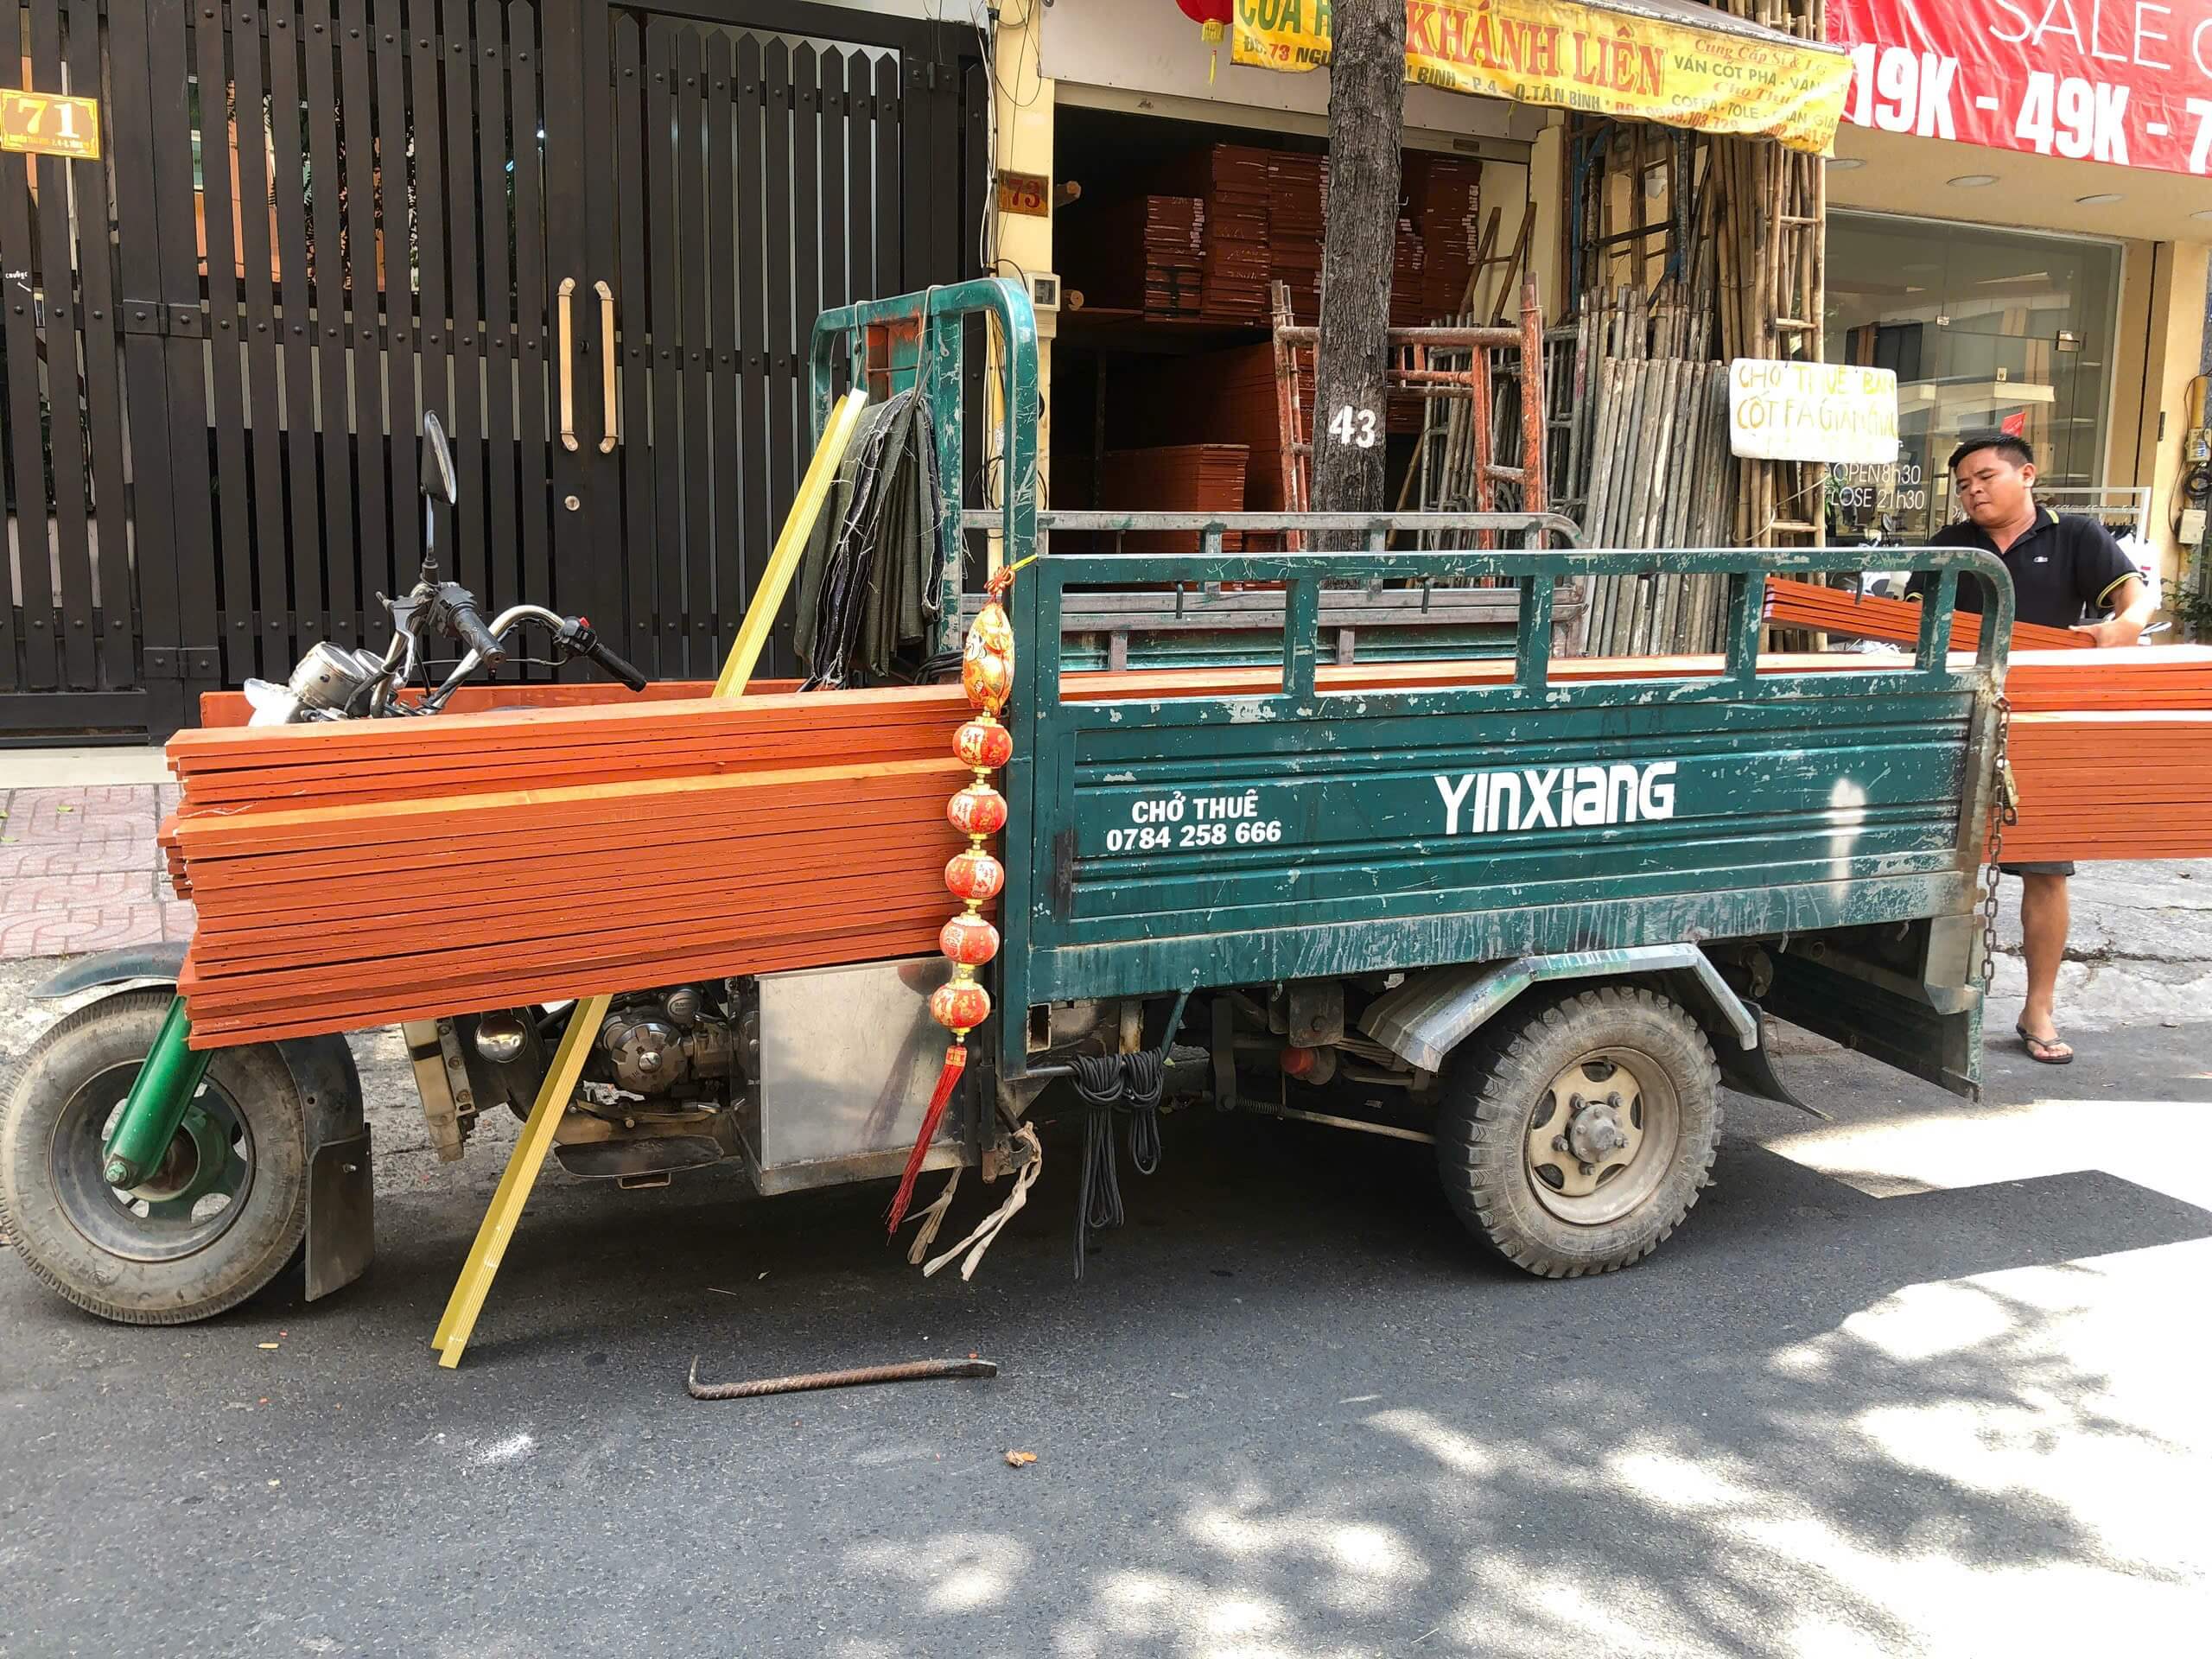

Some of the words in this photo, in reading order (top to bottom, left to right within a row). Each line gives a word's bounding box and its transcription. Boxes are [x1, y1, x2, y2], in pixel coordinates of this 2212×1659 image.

[1406, 0, 1560, 77] KHÁNH
[1573, 26, 1666, 97] LIÊN
[1694, 39, 1733, 60] Cung
[1990, 0, 2171, 70] SALE
[1268, 43, 1291, 61] 73
[1417, 65, 1456, 87] BÌNH
[1569, 90, 1601, 111] BÌNH
[1674, 54, 1707, 74] VÁN
[1713, 60, 1743, 79] CỐT
[1749, 71, 1777, 86] PHA
[18, 99, 79, 139] 71
[1672, 93, 1718, 113] COFFA
[1727, 101, 1759, 120] TOLE
[1849, 43, 1958, 140] 19K
[2015, 71, 2130, 165] 49K
[1007, 178, 1041, 208] 73
[1328, 404, 1376, 448] 43
[1833, 461, 1880, 484] OPEN
[1881, 464, 1922, 485] 8h30
[1830, 486, 1873, 508] LOSE
[1876, 487, 1925, 511] 21h30
[1131, 791, 1186, 823] CHỞ
[1193, 788, 1259, 820] THUÊ
[1106, 826, 1172, 852] 0784
[1179, 823, 1227, 848] 258
[1235, 820, 1281, 845] 666
